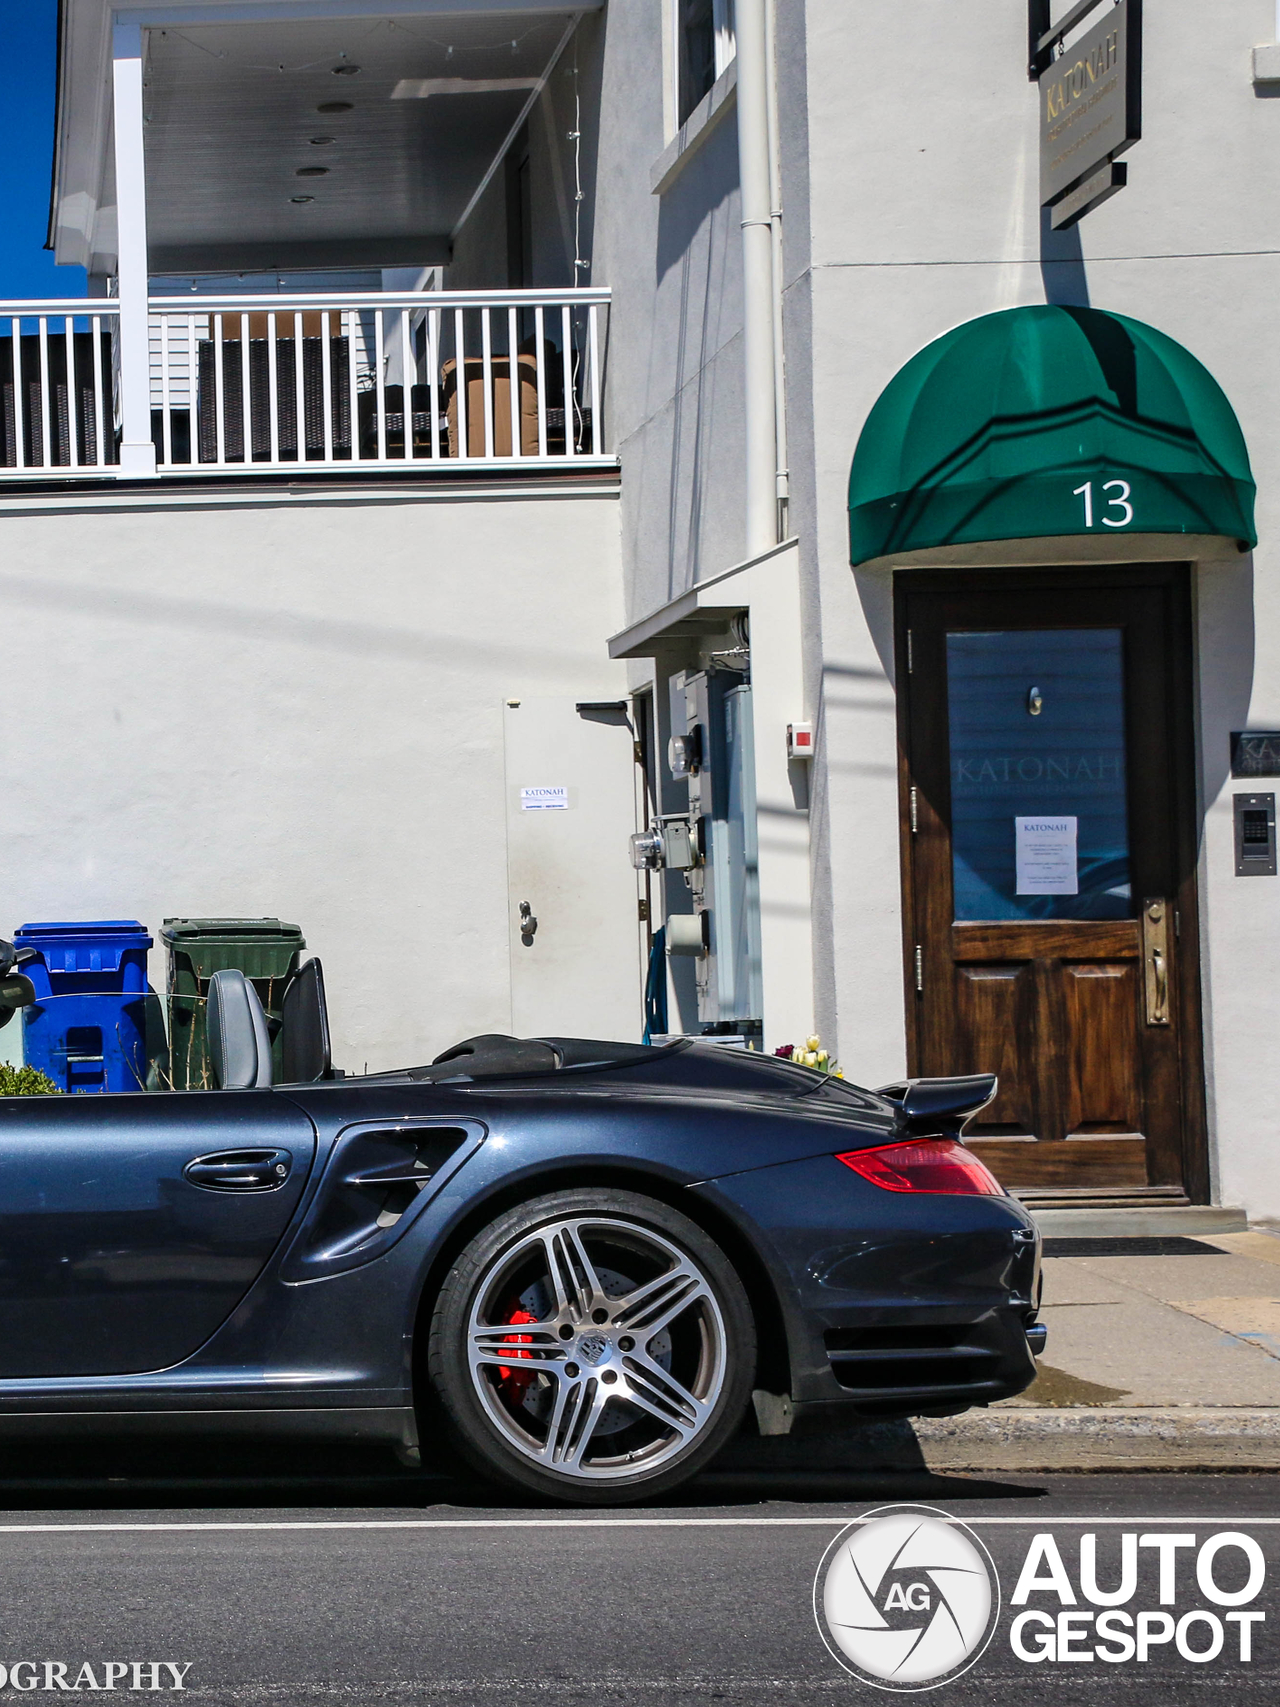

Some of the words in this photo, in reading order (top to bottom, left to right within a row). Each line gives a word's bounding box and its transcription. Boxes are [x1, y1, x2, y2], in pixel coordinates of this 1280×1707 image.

[1047, 28, 1118, 123] KATONAH
[1072, 479, 1134, 528] 13
[1241, 739, 1280, 758] KA
[956, 756, 1121, 783] KATONAH
[1024, 824, 1067, 832] KATONAH
